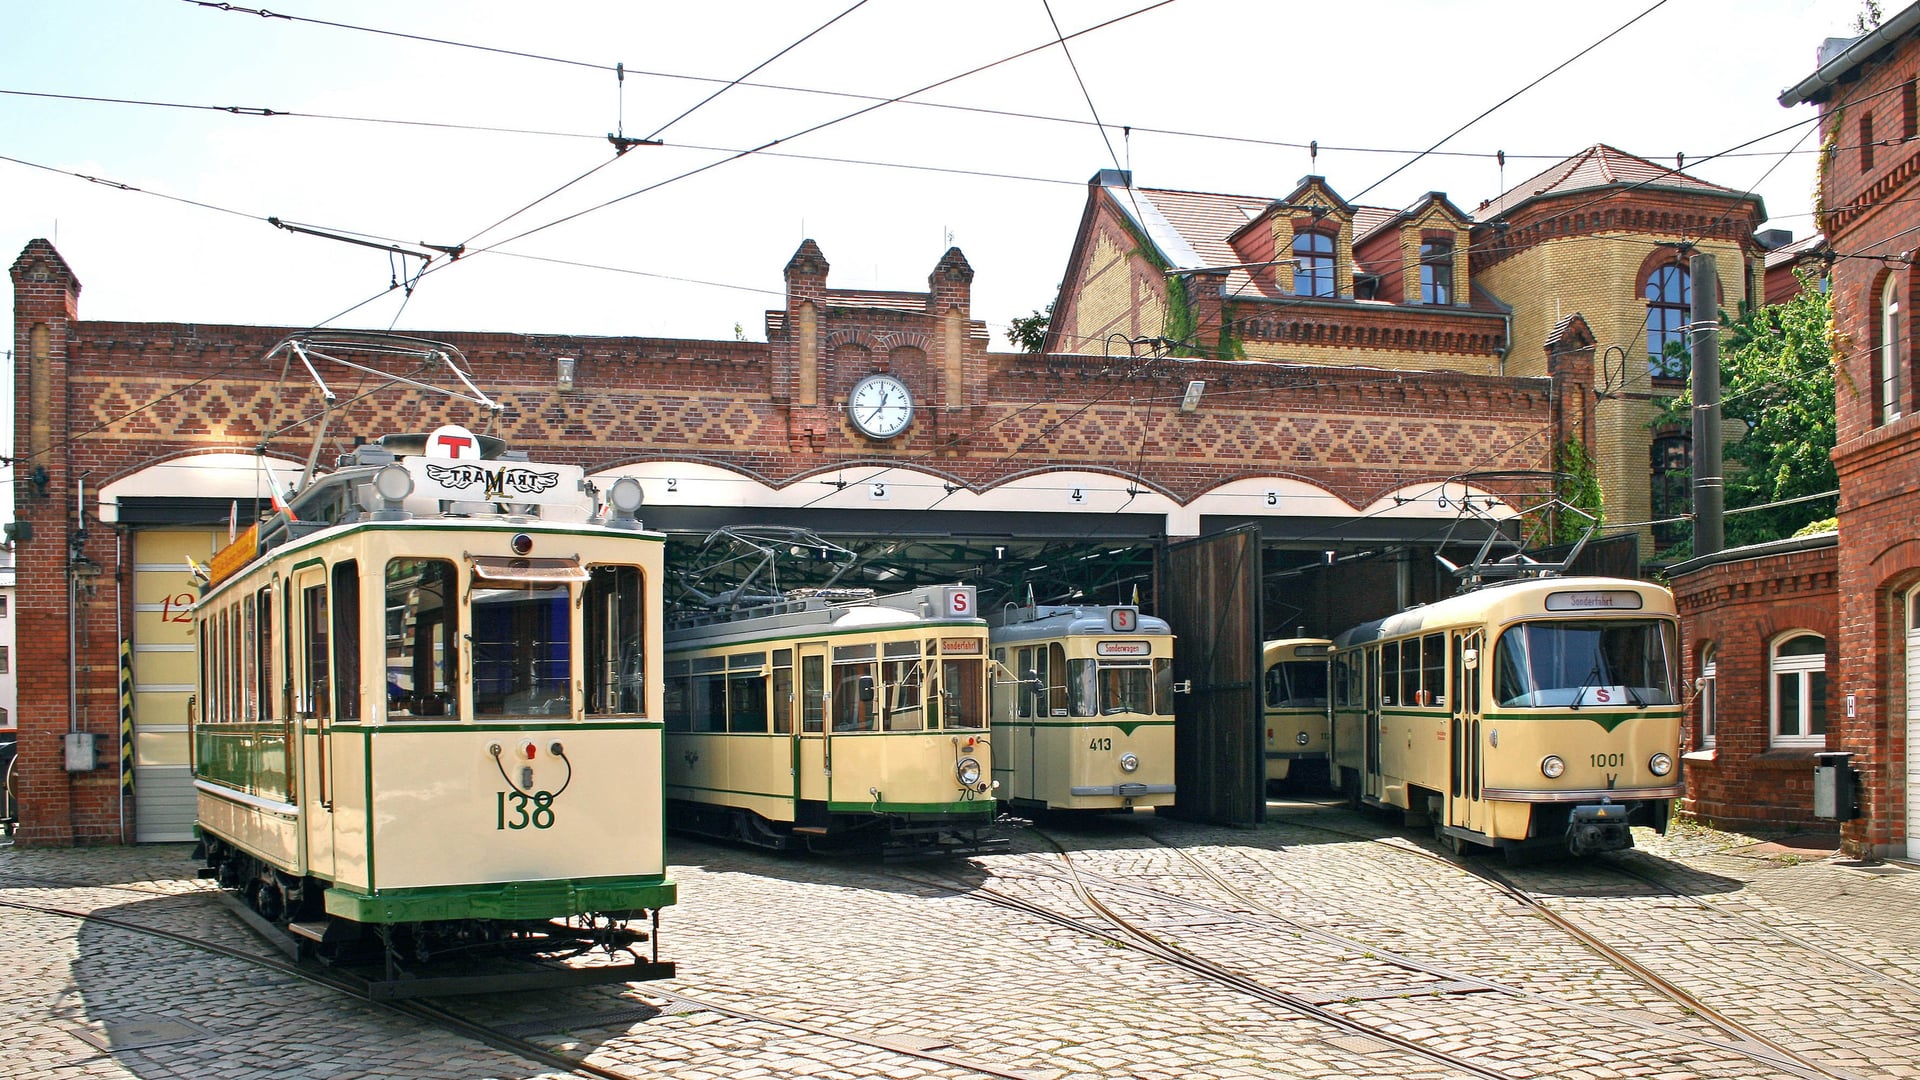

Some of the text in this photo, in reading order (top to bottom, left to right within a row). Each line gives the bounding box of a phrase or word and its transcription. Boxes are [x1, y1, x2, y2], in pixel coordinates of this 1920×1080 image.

[667, 478, 677, 492] 2
[874, 483, 884, 496] 3
[1072, 488, 1082, 501] 4
[1268, 492, 1277, 505] 5
[1439, 496, 1447, 508] 6
[996, 547, 1004, 559] T
[1325, 551, 1334, 563] T
[953, 593, 967, 612] S
[1571, 595, 1613, 606] Sonderfahrt
[160, 593, 195, 622] 12
[1119, 611, 1127, 626] S
[943, 641, 976, 650] Sonderfahrt
[1105, 643, 1140, 654] Sonderwagen
[1596, 689, 1610, 702] S
[1848, 698, 1854, 715] H
[1089, 738, 1111, 751] 413
[1590, 753, 1624, 768] 1001
[958, 788, 975, 802] 70
[496, 790, 556, 830] 138
